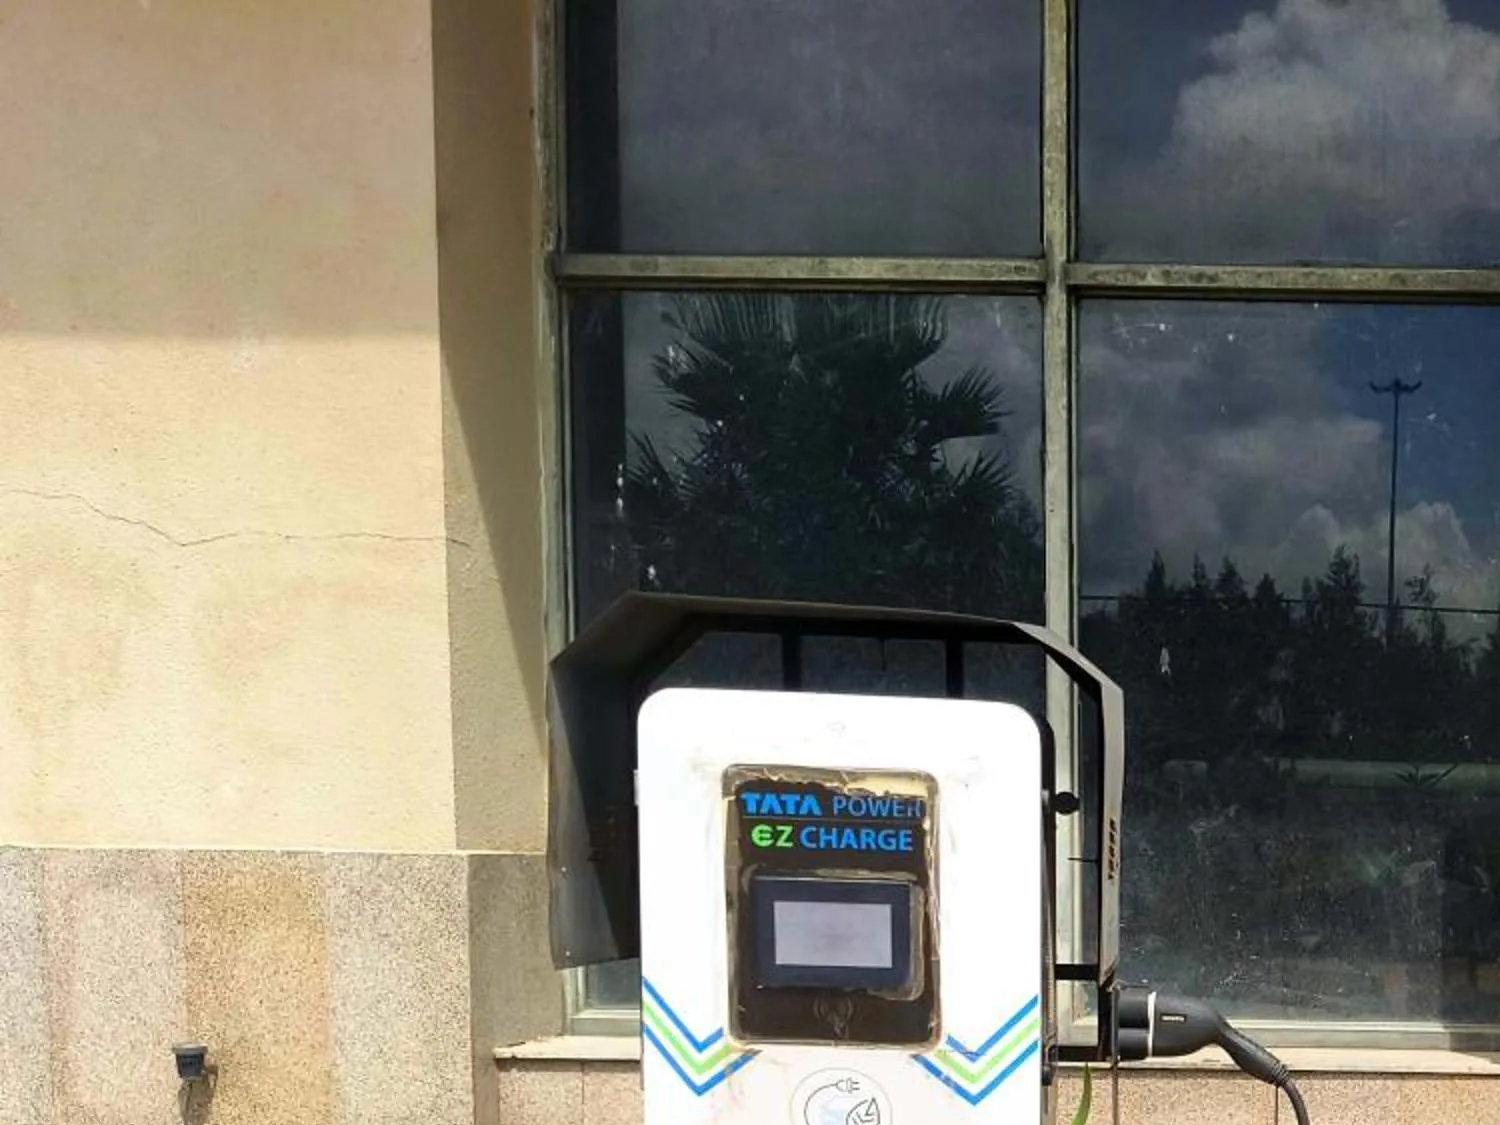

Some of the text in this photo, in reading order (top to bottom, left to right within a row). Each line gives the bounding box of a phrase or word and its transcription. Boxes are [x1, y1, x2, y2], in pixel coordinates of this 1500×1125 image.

[740, 792, 921, 818] TATA POWER
[799, 826, 913, 850] CHARGE
